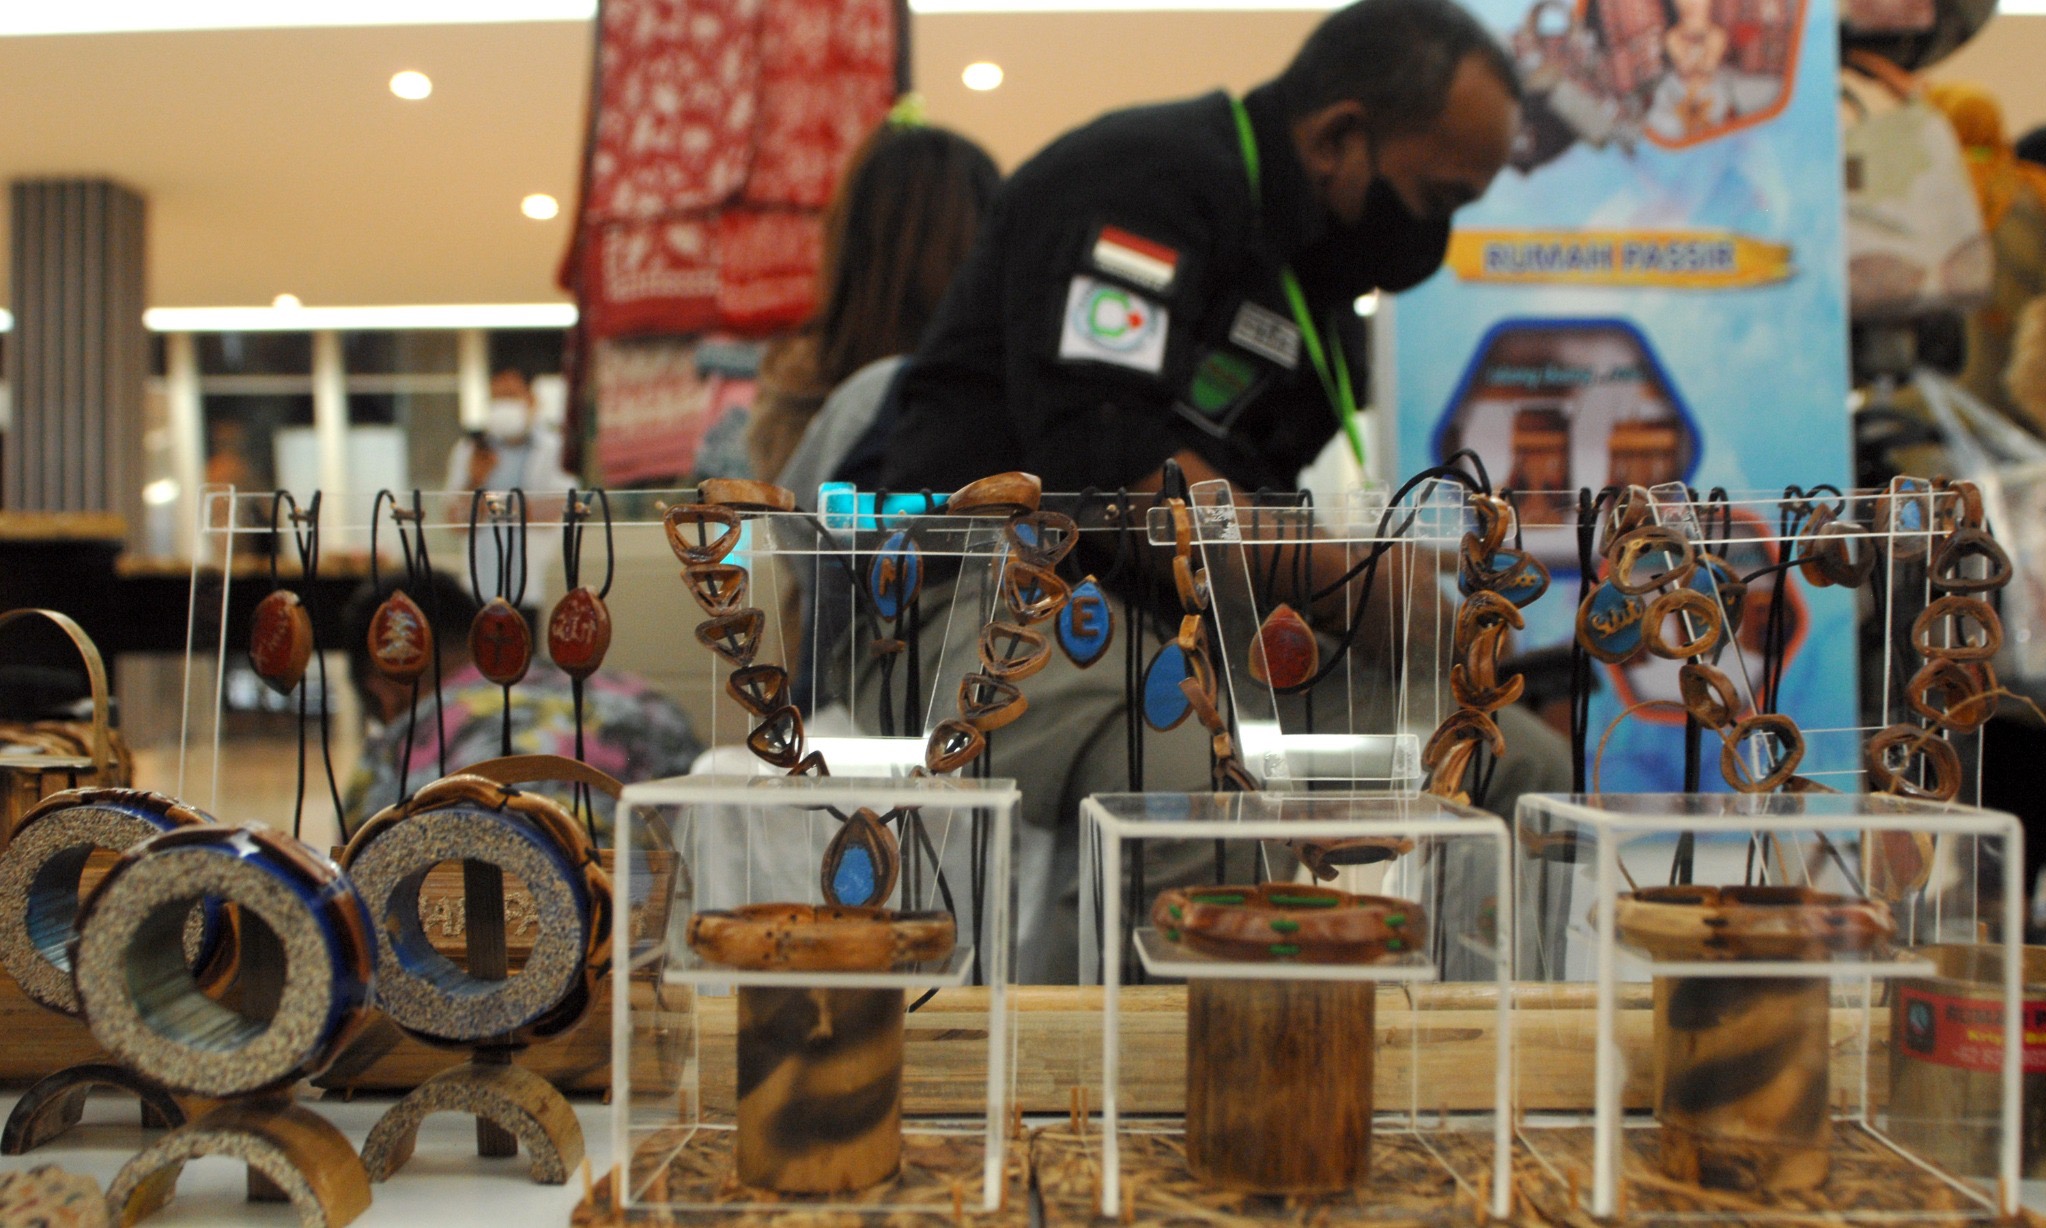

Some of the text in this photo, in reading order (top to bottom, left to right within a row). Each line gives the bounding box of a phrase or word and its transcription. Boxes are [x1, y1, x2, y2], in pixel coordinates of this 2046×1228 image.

[1487, 243, 1734, 271] RUMAH PASSIR
[1070, 596, 1100, 637] E
